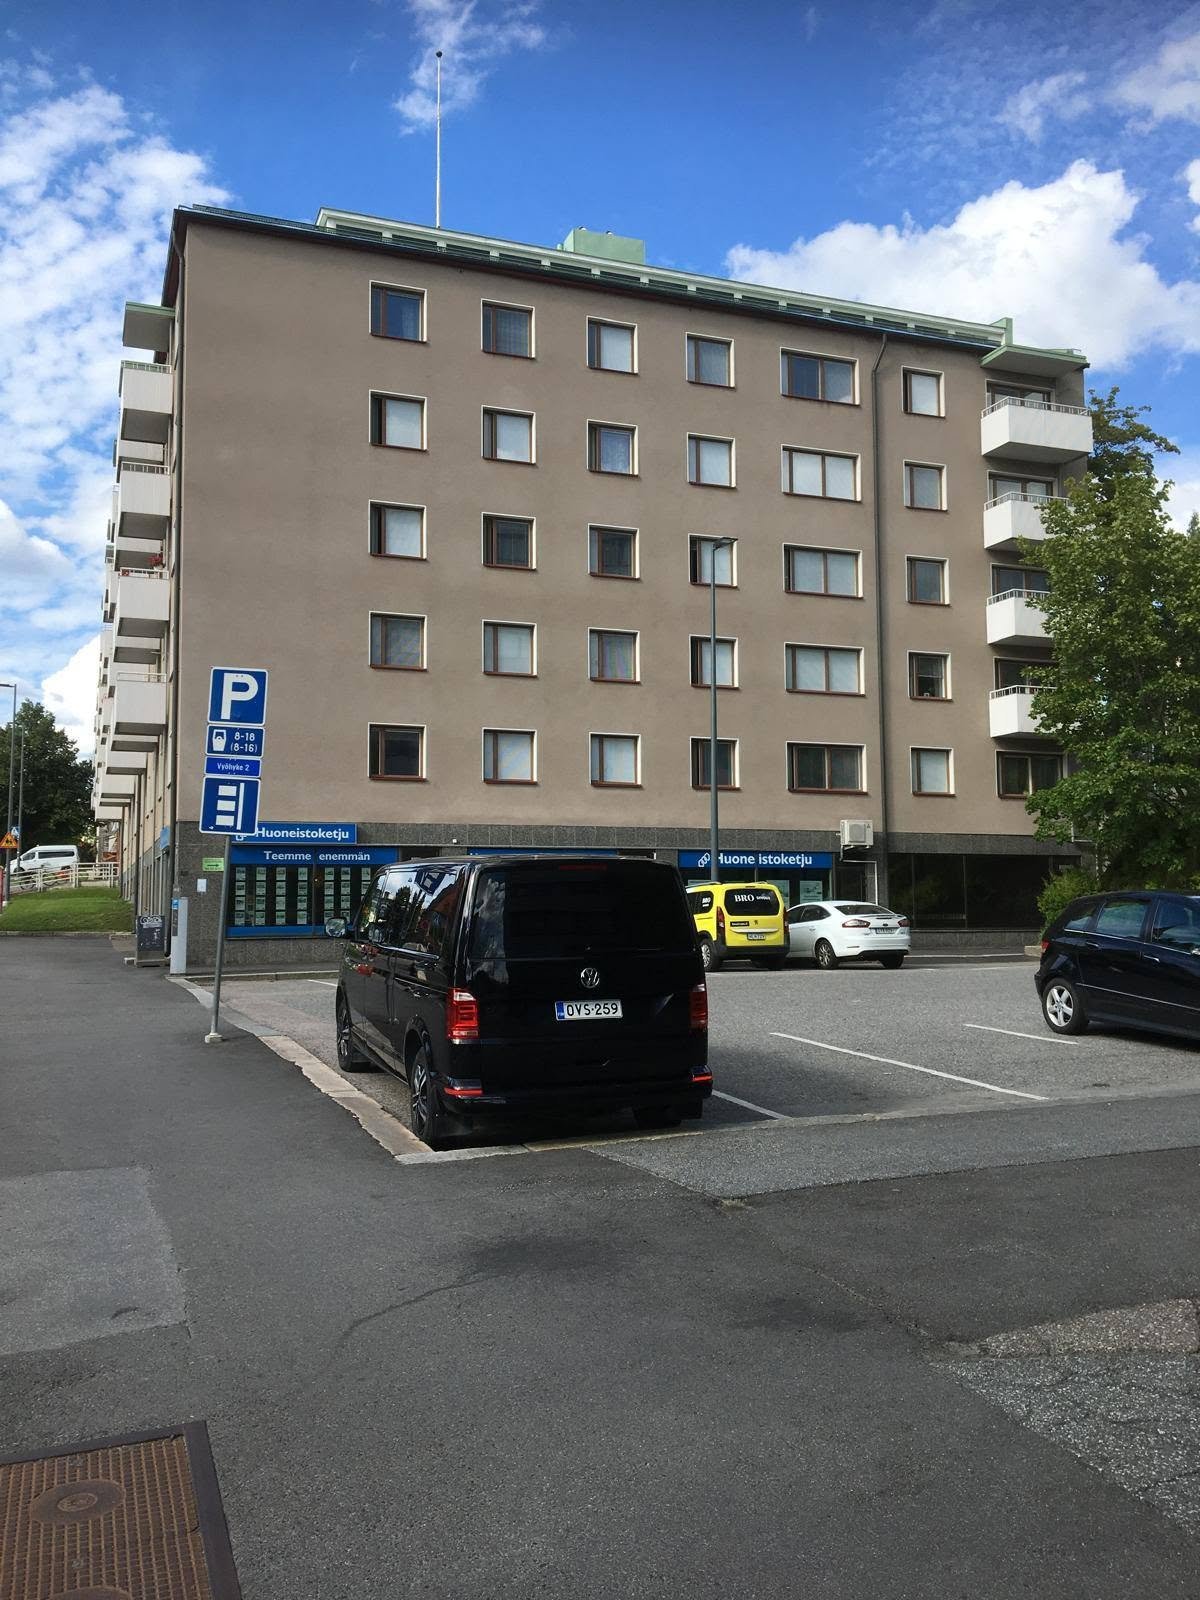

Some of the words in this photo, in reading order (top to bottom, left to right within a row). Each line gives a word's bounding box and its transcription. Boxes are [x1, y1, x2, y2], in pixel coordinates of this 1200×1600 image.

[220, 672, 259, 720] P
[234, 731, 256, 742] 8-18
[230, 742, 258, 753] (8-16)
[217, 762, 244, 772] Vyöhyke
[244, 764, 250, 772] 2
[256, 827, 350, 841] Huoneistoketju
[263, 850, 312, 861] Teemme
[318, 851, 371, 861] enemmän
[734, 893, 755, 903] BRO
[566, 1002, 618, 1017] OVS-259
